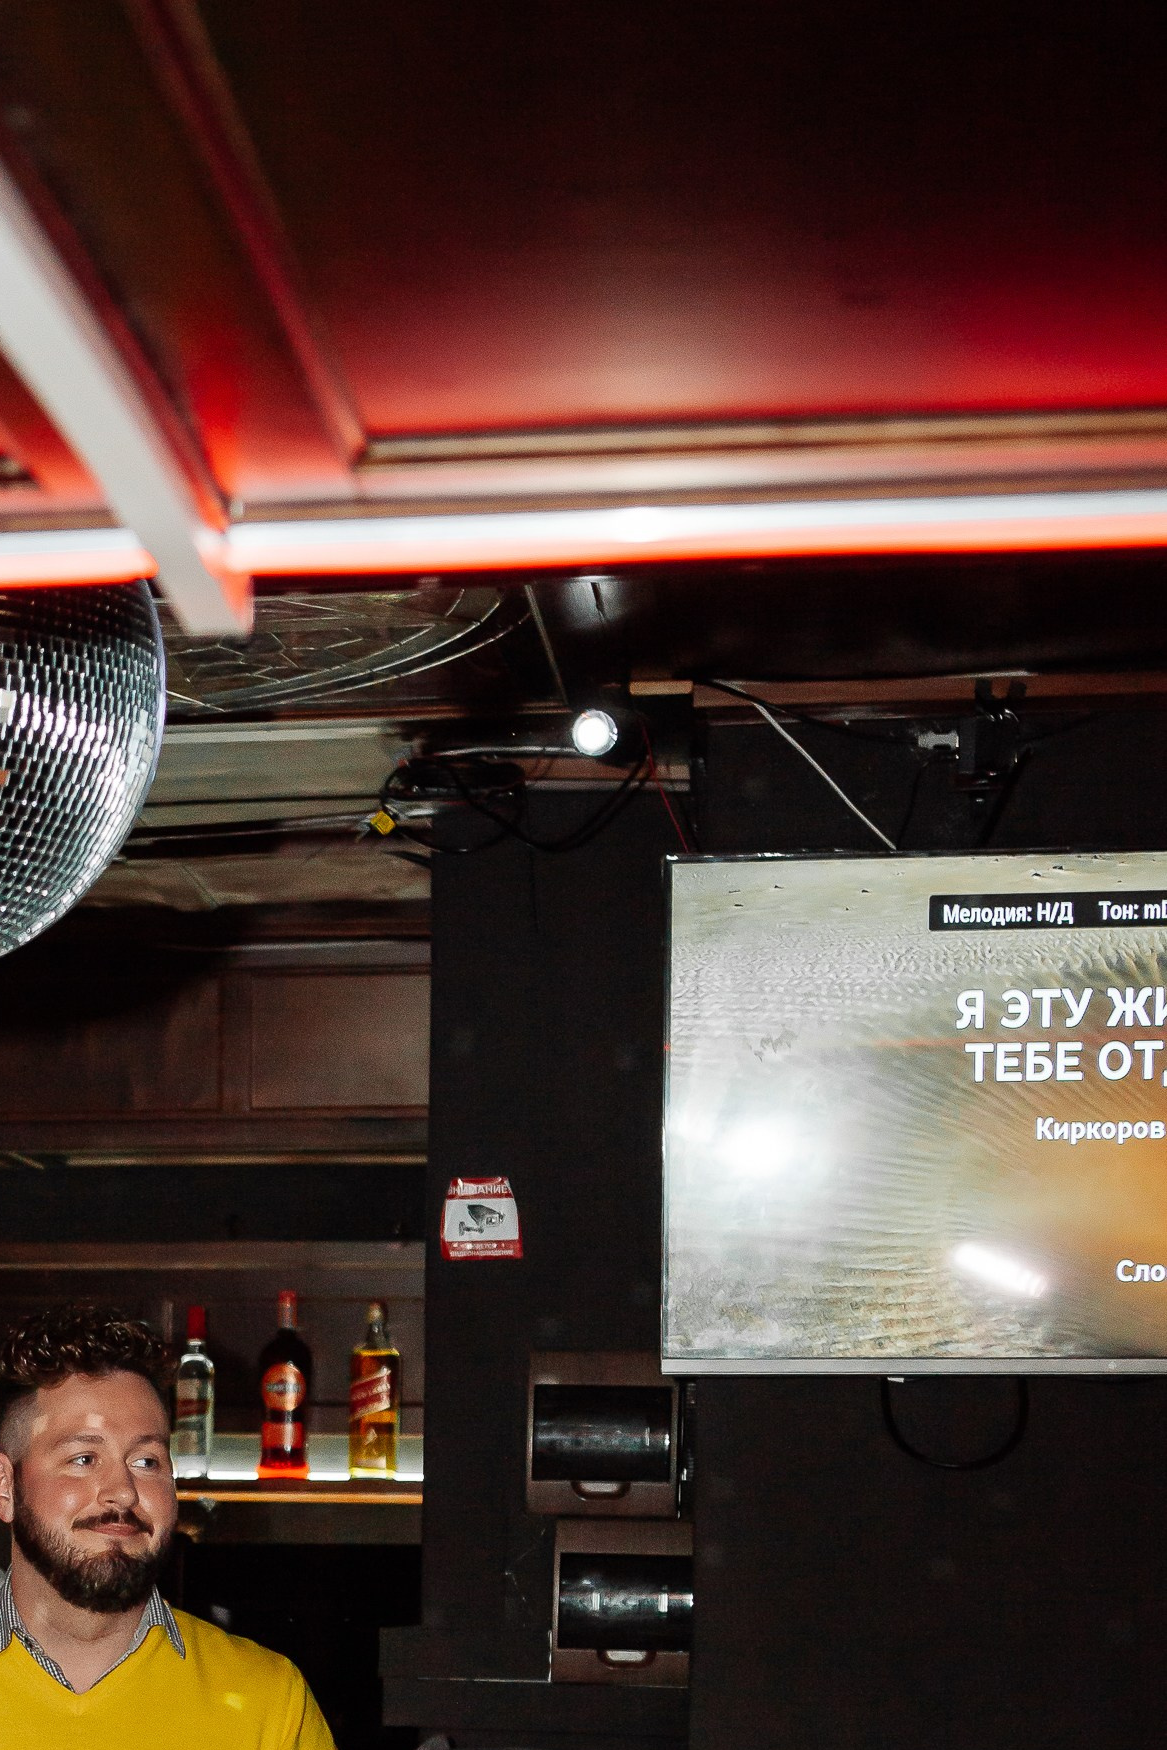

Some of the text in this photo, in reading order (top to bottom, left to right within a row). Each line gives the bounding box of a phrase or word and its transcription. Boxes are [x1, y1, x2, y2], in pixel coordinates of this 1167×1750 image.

[943, 904, 1032, 926] Мелодия:
[1037, 901, 1074, 925] Н/Д
[1098, 900, 1139, 921] Тон:
[955, 989, 984, 1029] Я
[1000, 987, 1093, 1028] ЭТУ
[964, 1040, 1167, 1088] ТЕБЕ ОТ
[1036, 1116, 1166, 1145] Киркоров
